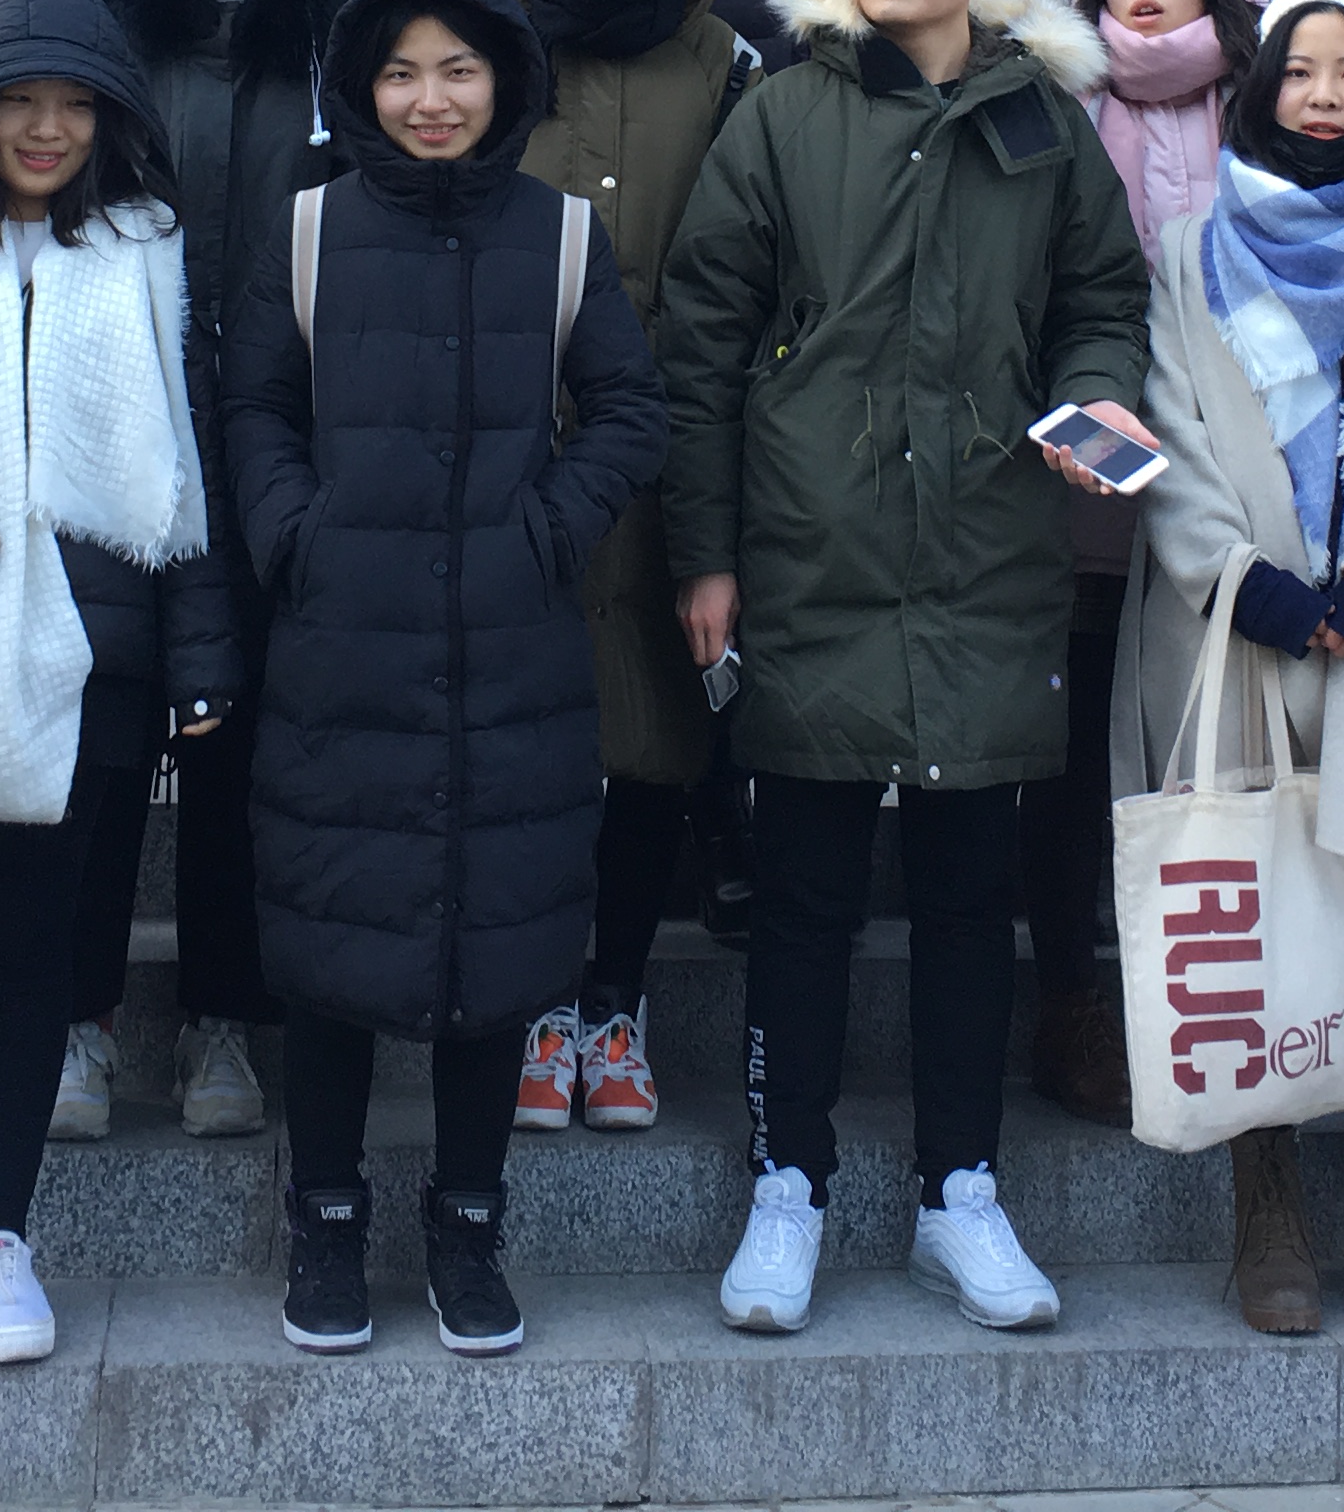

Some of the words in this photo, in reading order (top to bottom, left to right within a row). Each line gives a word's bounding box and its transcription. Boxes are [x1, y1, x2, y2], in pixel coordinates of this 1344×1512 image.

[1159, 858, 1267, 1095] RUC
[748, 1025, 767, 1085] PAUL
[320, 1205, 353, 1220] VANS
